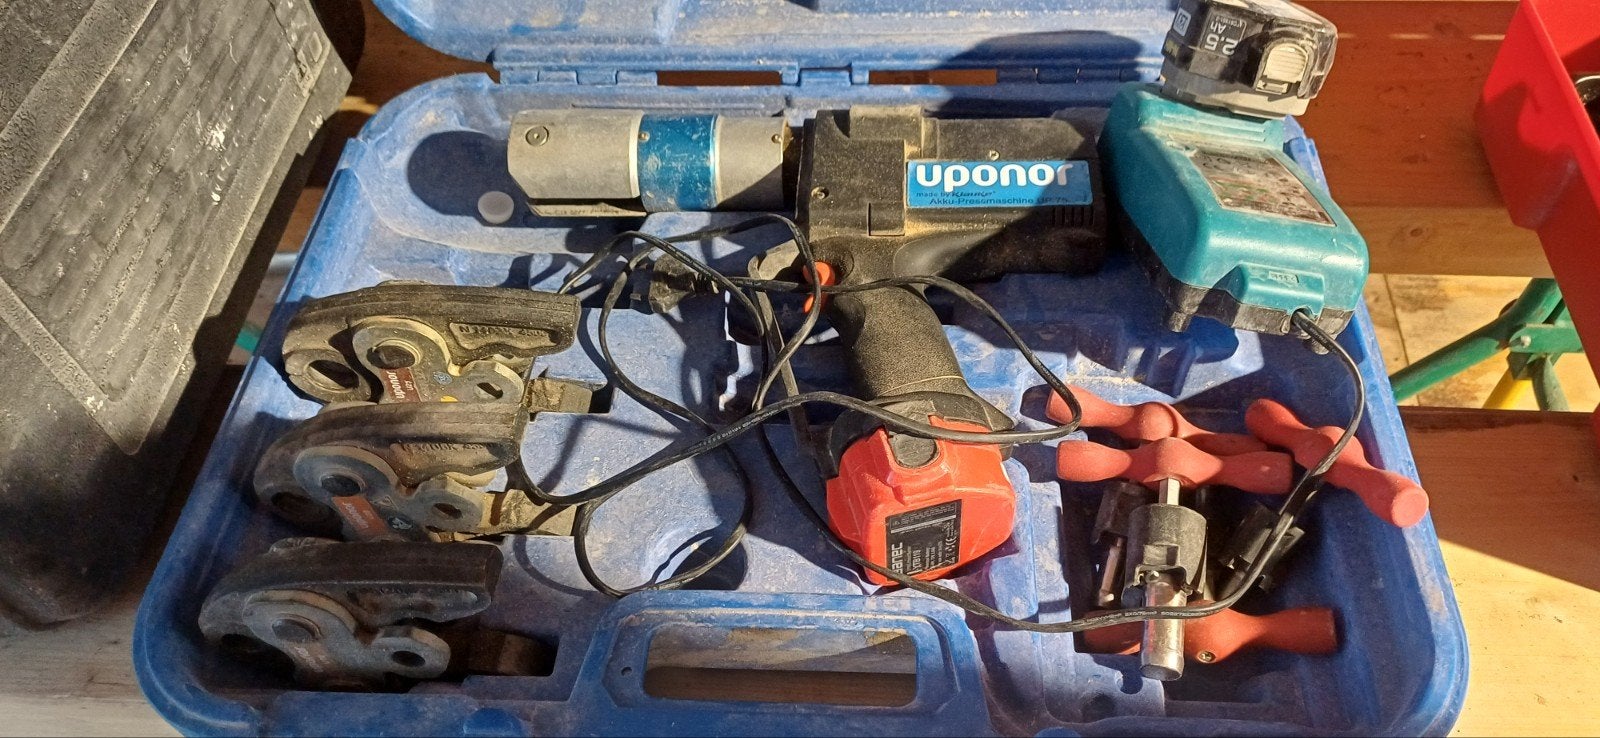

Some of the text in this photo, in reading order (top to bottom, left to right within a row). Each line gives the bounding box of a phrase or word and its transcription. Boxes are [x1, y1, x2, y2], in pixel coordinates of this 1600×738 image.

[1210, 20, 1227, 34] Ah
[1203, 33, 1239, 56] 2.5
[916, 163, 1074, 193] uponor
[386, 371, 405, 400] uponor
